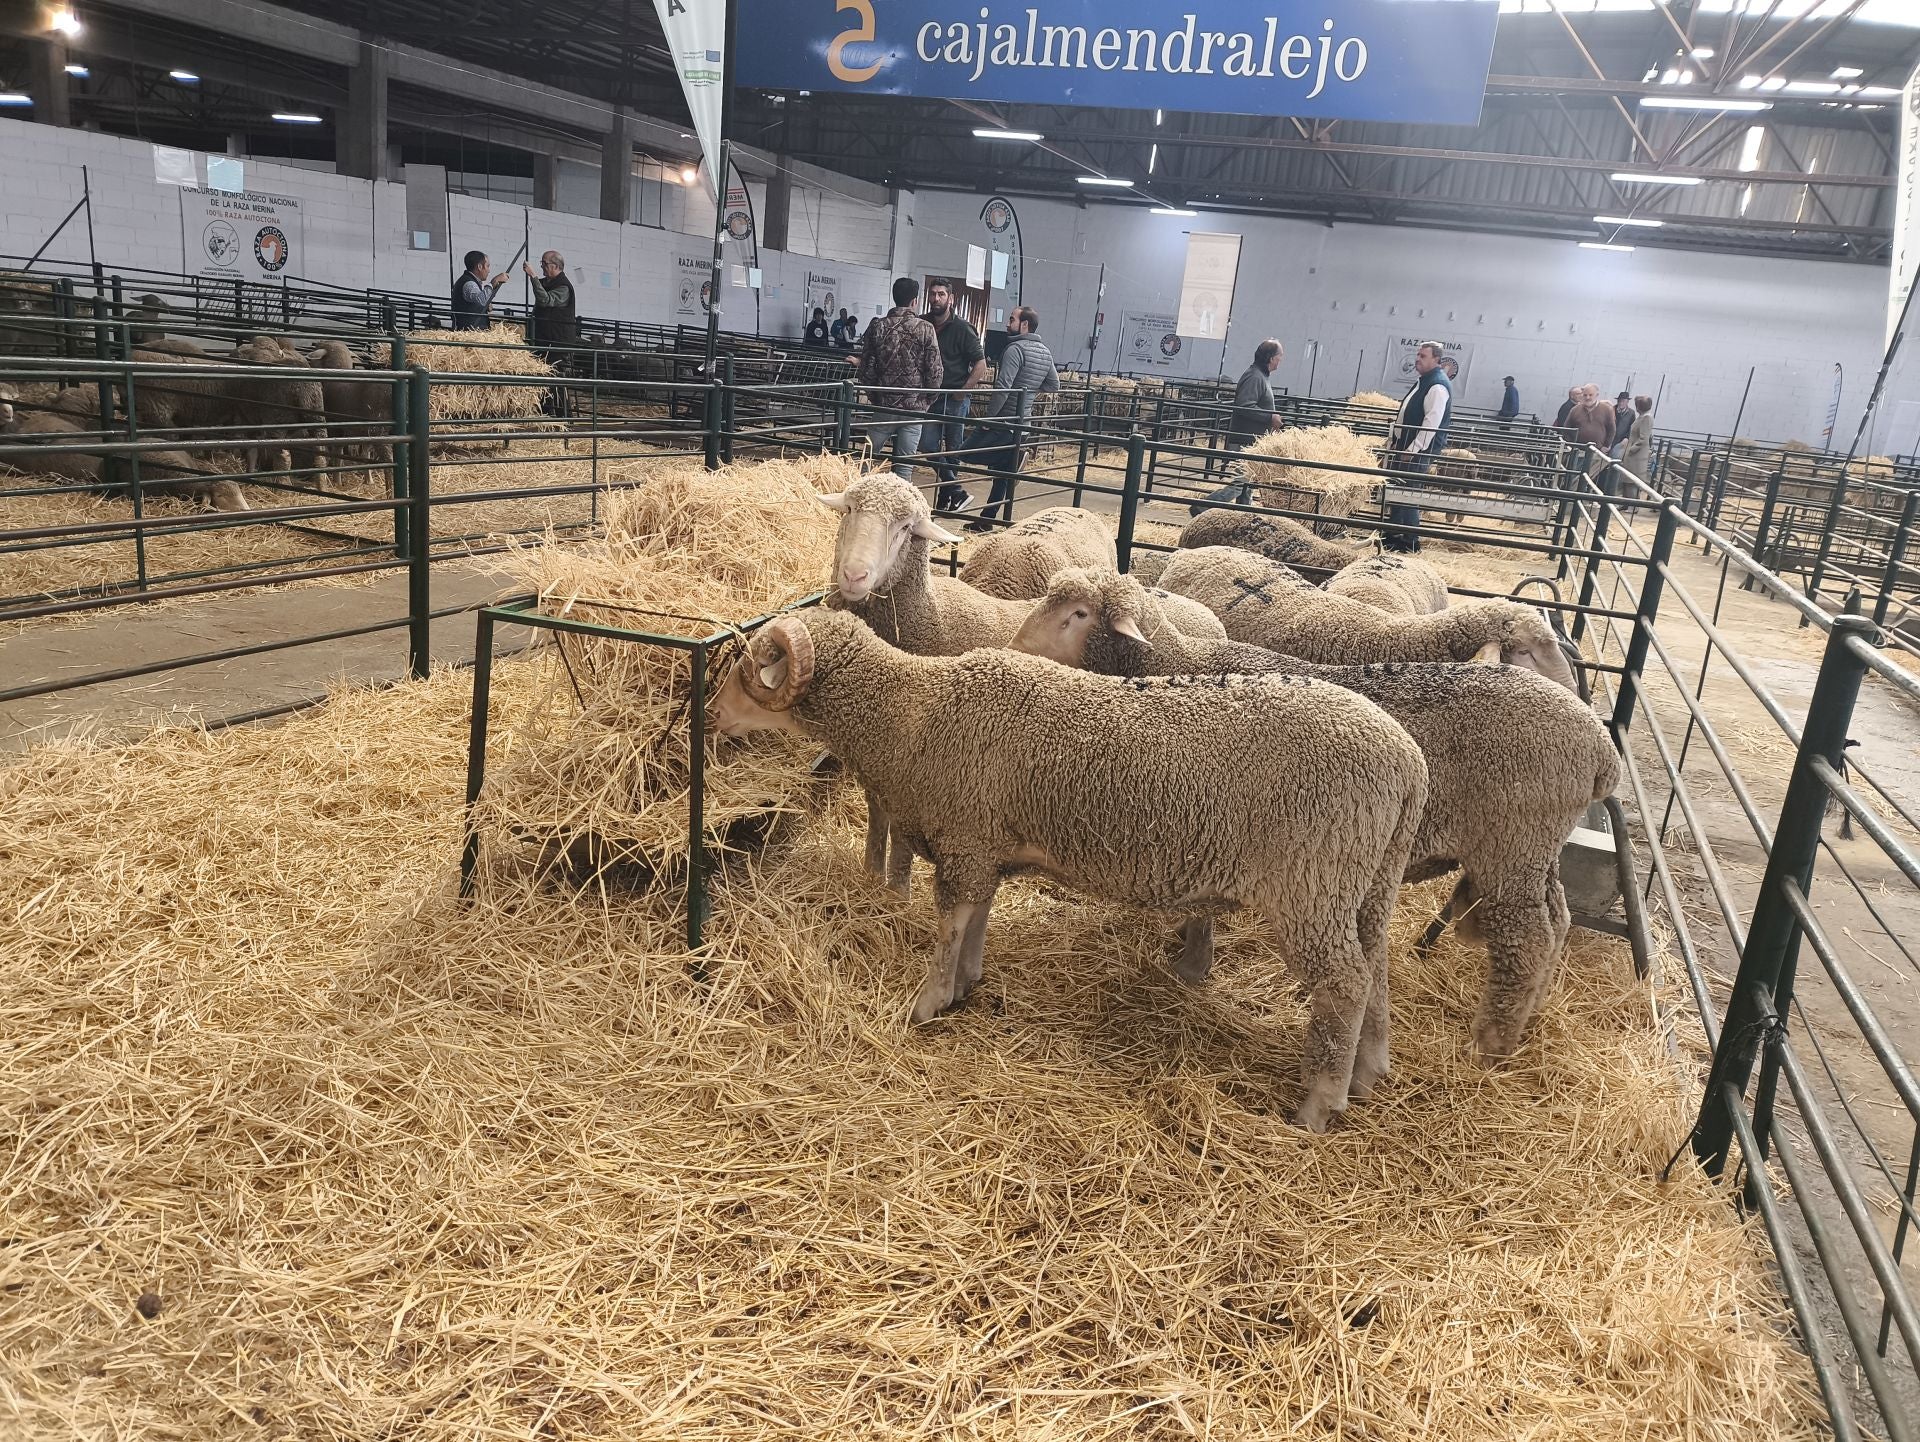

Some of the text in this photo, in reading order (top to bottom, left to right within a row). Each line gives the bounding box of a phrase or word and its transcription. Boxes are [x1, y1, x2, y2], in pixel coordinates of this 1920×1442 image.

[916, 8, 1368, 99] cajalmendralejo
[210, 198, 276, 214] DE LA RAZA MERINA
[269, 197, 299, 208] NACIONAL
[206, 209, 223, 218] 100%
[224, 211, 242, 220] RAZA
[678, 257, 712, 270] RAZA MERIN
[262, 273, 282, 281] MERINA
[811, 274, 820, 283] AZA
